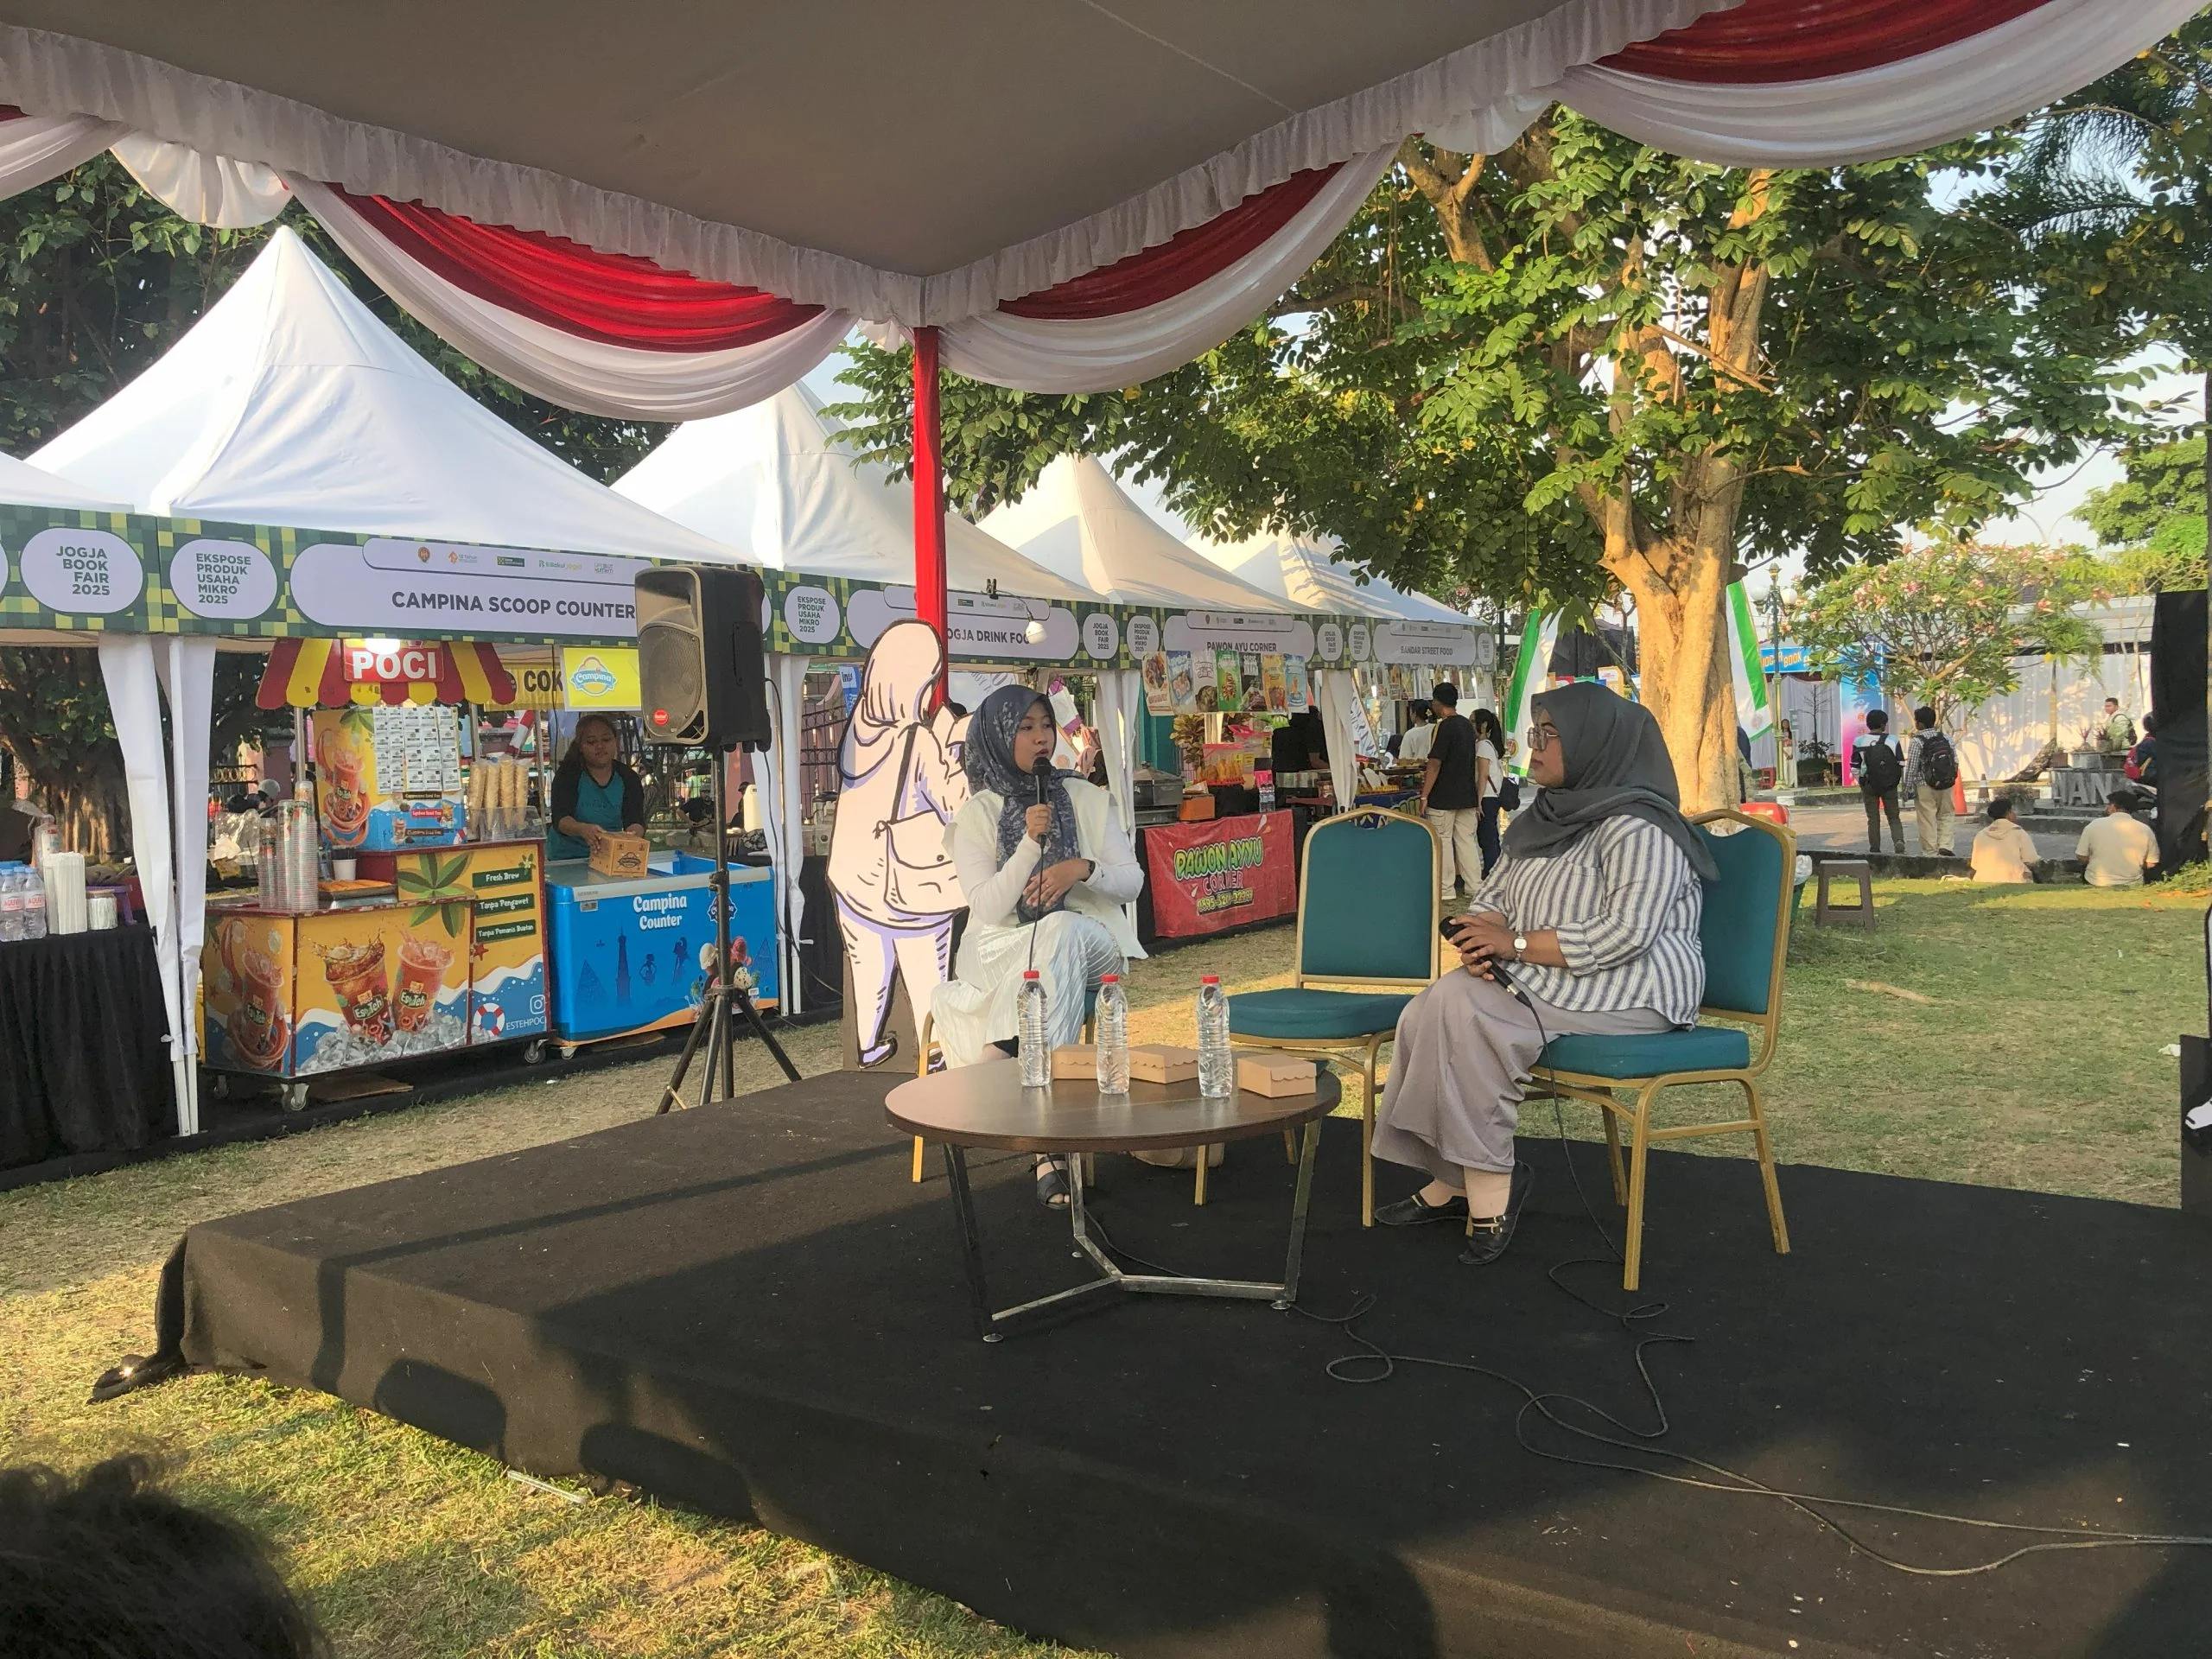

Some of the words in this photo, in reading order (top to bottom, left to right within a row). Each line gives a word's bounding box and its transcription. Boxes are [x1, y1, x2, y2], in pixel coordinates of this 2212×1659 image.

[56, 546, 107, 559] JOGJA
[62, 559, 109, 571] BOOK
[196, 553, 251, 565] EKSPOSE
[196, 563, 248, 575] PRODUK
[74, 571, 109, 584] FAIR
[197, 575, 240, 585] USAHA
[72, 584, 110, 596] 2025
[198, 584, 238, 594] MIKRO
[199, 594, 228, 604] 2025
[392, 591, 484, 612] CAMPINA
[488, 596, 551, 614] SCOOP
[556, 601, 635, 619] COUNTER
[798, 596, 826, 605] EKSPOSE
[947, 627, 975, 641] OGJA
[976, 631, 1007, 643] DRINK
[1207, 642, 1232, 651] PAWON
[1235, 643, 1248, 652] AYU
[1249, 643, 1277, 652] CORNER
[1422, 646, 1439, 655] STREET
[353, 651, 436, 679] POCI
[575, 670, 612, 683] Campina
[1174, 842, 1227, 880] PAWON
[486, 873, 503, 882] Fresh
[504, 872, 519, 880] Brew
[480, 901, 499, 911] Tanpa
[499, 897, 529, 910] Pengawet
[633, 893, 687, 914] Campina
[639, 915, 683, 931] Counter
